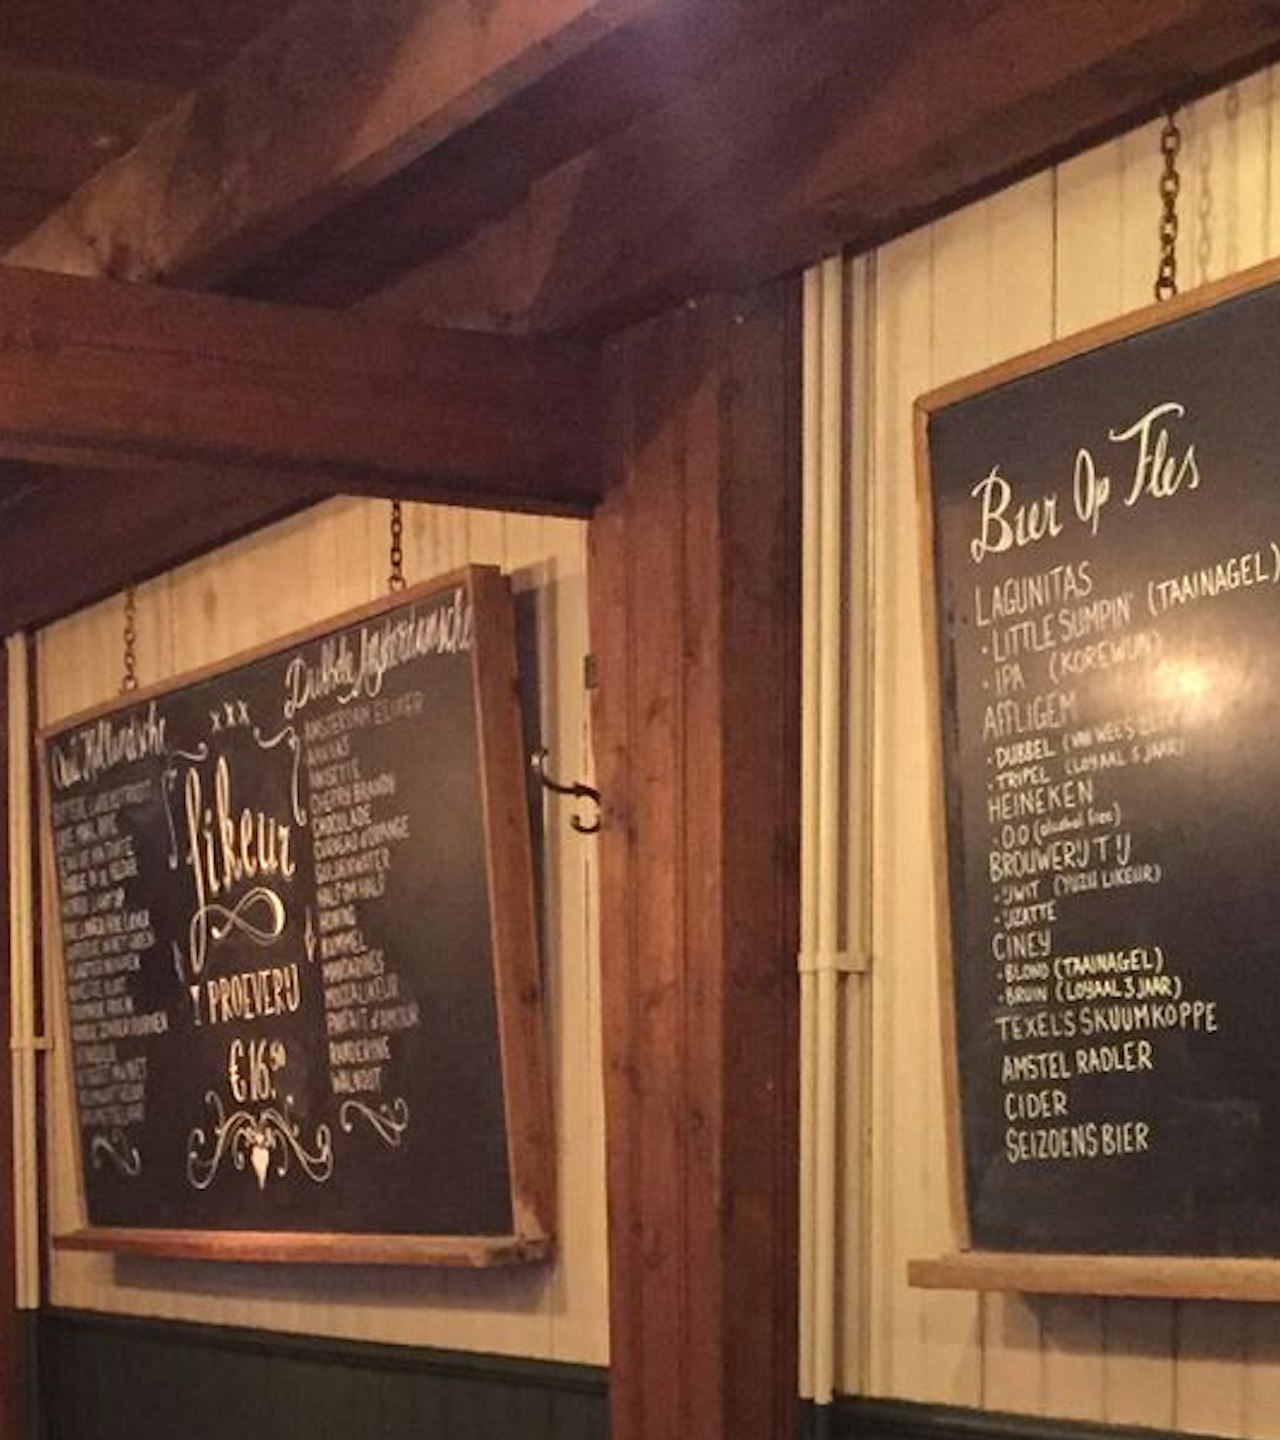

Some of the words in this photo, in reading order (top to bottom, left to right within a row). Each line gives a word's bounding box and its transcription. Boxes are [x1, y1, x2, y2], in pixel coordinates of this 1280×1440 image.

[971, 466, 1062, 563] Bier
[1073, 449, 1110, 535] Op
[1109, 403, 1200, 505] Fles
[975, 560, 1092, 627] LAGUNITAS
[992, 614, 1056, 662] LITTLE
[995, 663, 1024, 695] IPA
[995, 738, 1057, 768] DUBBEL
[996, 765, 1050, 790] TRIPEL
[988, 777, 1093, 823] HEINEKEN
[989, 838, 1090, 882] BROUWERIJ
[992, 929, 1052, 961] CINEY
[1004, 962, 1050, 982] BLOND
[207, 963, 300, 1025] PROEVERIJ
[1006, 985, 1048, 1006] BRUIN
[1079, 1001, 1218, 1036] SKUUMKOPPE
[1001, 1050, 1070, 1084] AMSTEL
[1076, 1040, 1153, 1076] RADLER
[1005, 1091, 1067, 1121] CIDER
[1005, 1122, 1150, 1163] SEIZOENSBIER
